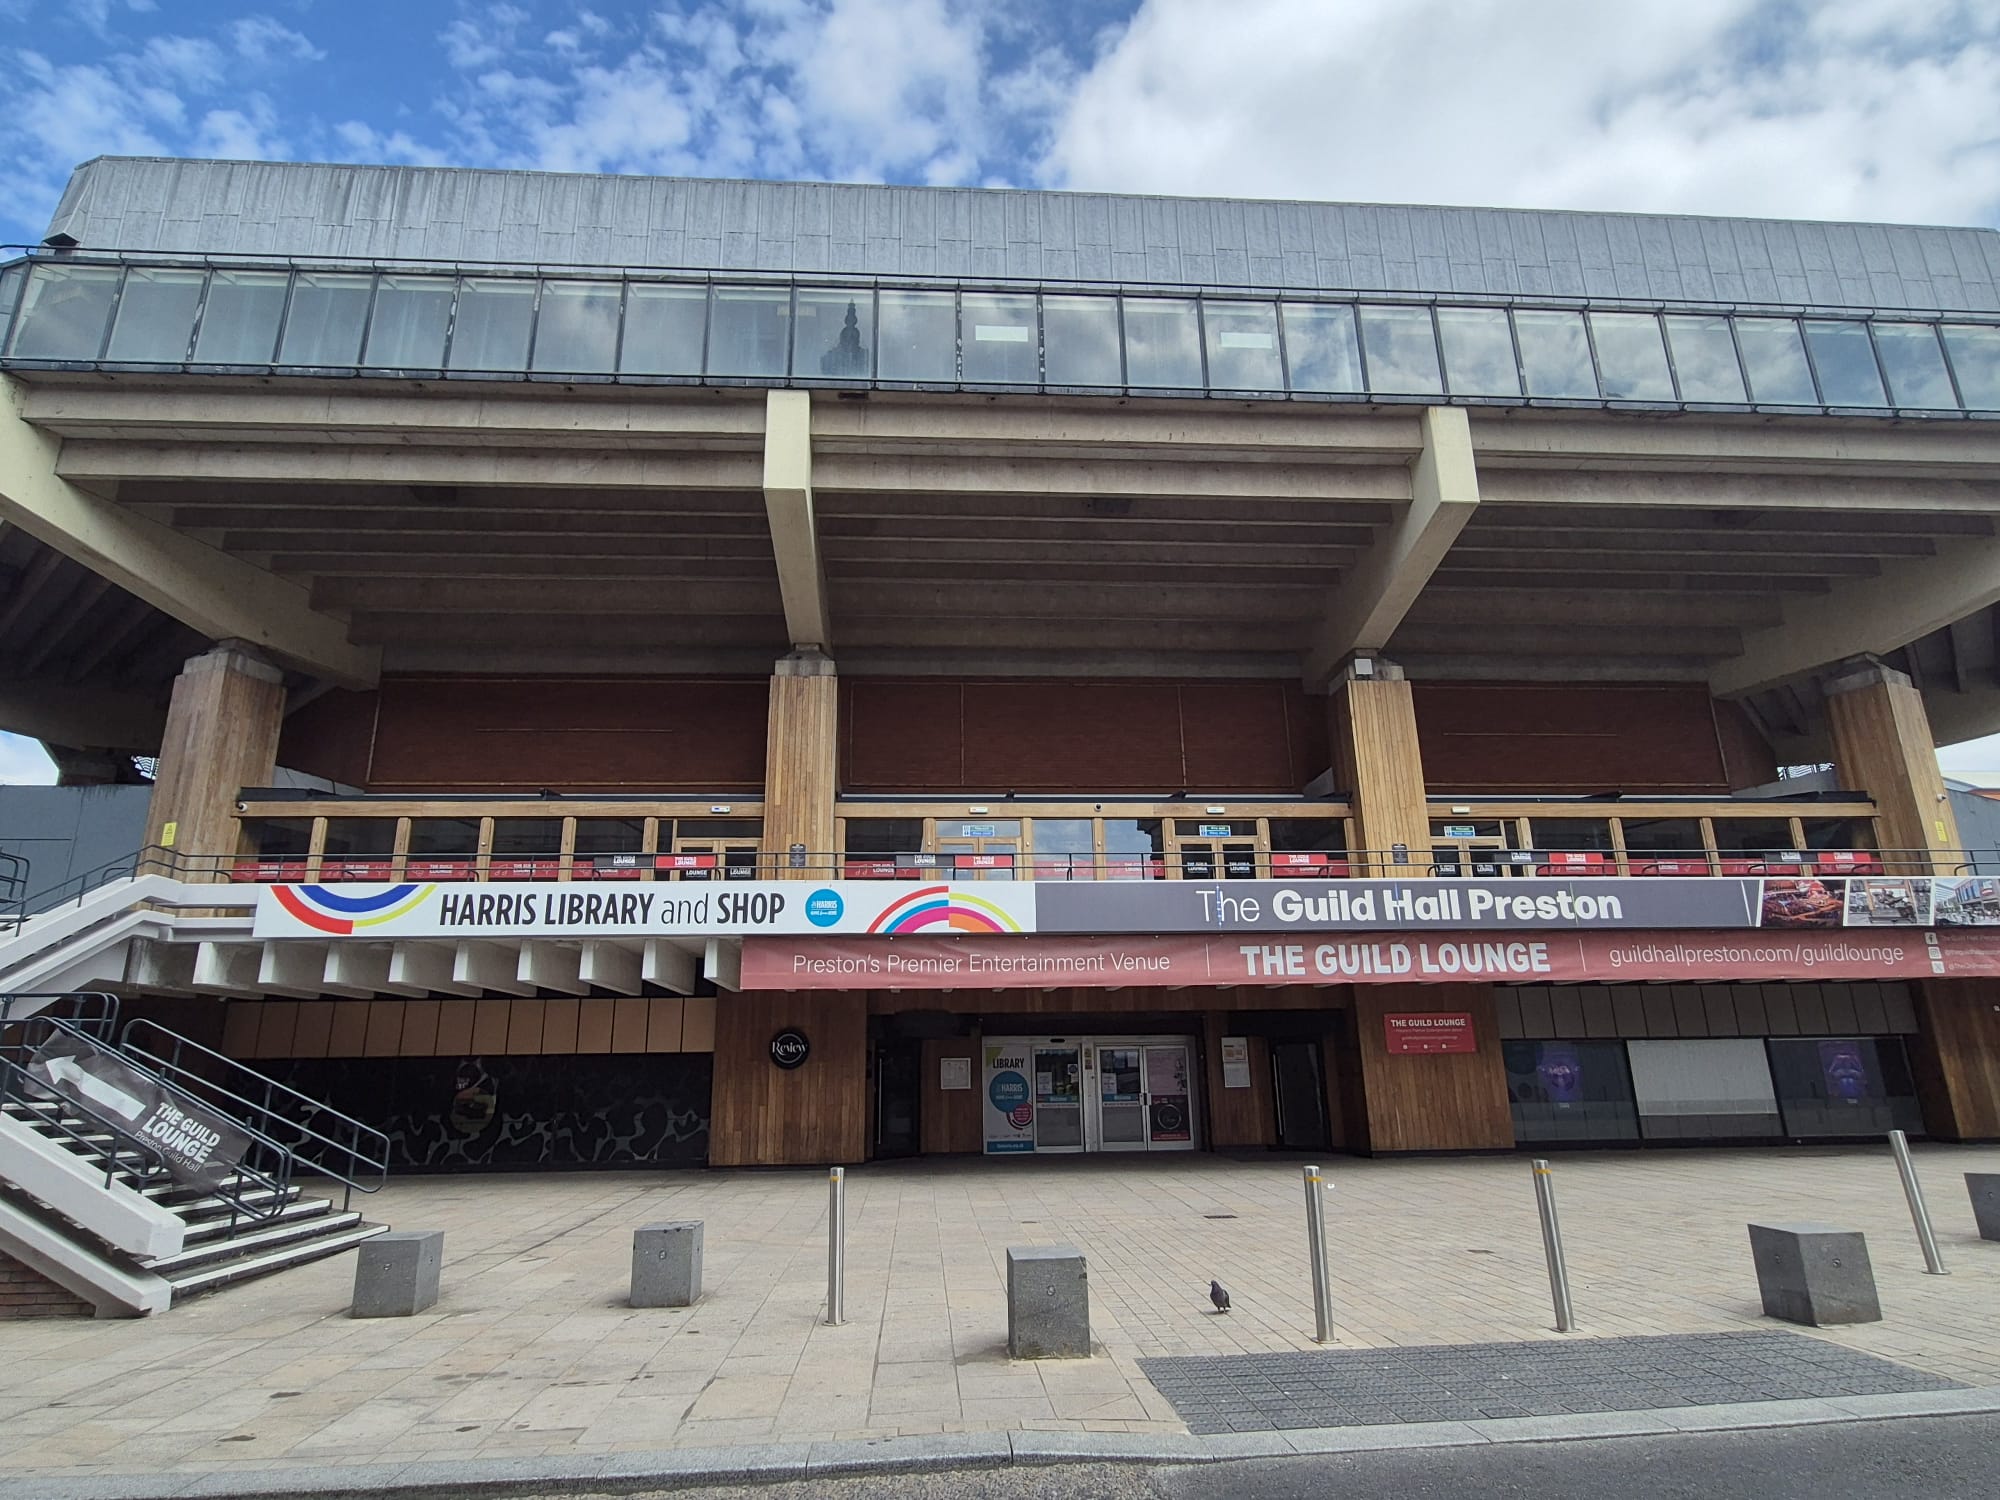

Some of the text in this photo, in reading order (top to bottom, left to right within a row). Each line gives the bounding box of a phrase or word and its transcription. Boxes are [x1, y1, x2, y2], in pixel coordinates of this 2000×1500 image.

[440, 893, 785, 926] HARRIS LIBRARY and SHOP
[1196, 888, 1624, 923] The Guild Hall Preston
[793, 952, 1170, 974] Preston's Premier Entertainment Venue
[1240, 942, 1551, 976] THE GUILD LOUNGE
[1609, 943, 1904, 968] guildhallpreston.com/guildlounge
[1390, 1018, 1466, 1027] THE GUILD LOUNGE
[771, 1041, 808, 1056] Review
[992, 1057, 1025, 1069] LIBRARY
[141, 1115, 213, 1164] LOUNGE
[156, 1102, 221, 1148] THE GUILD
[134, 1130, 202, 1173] Preston Guild Hall
